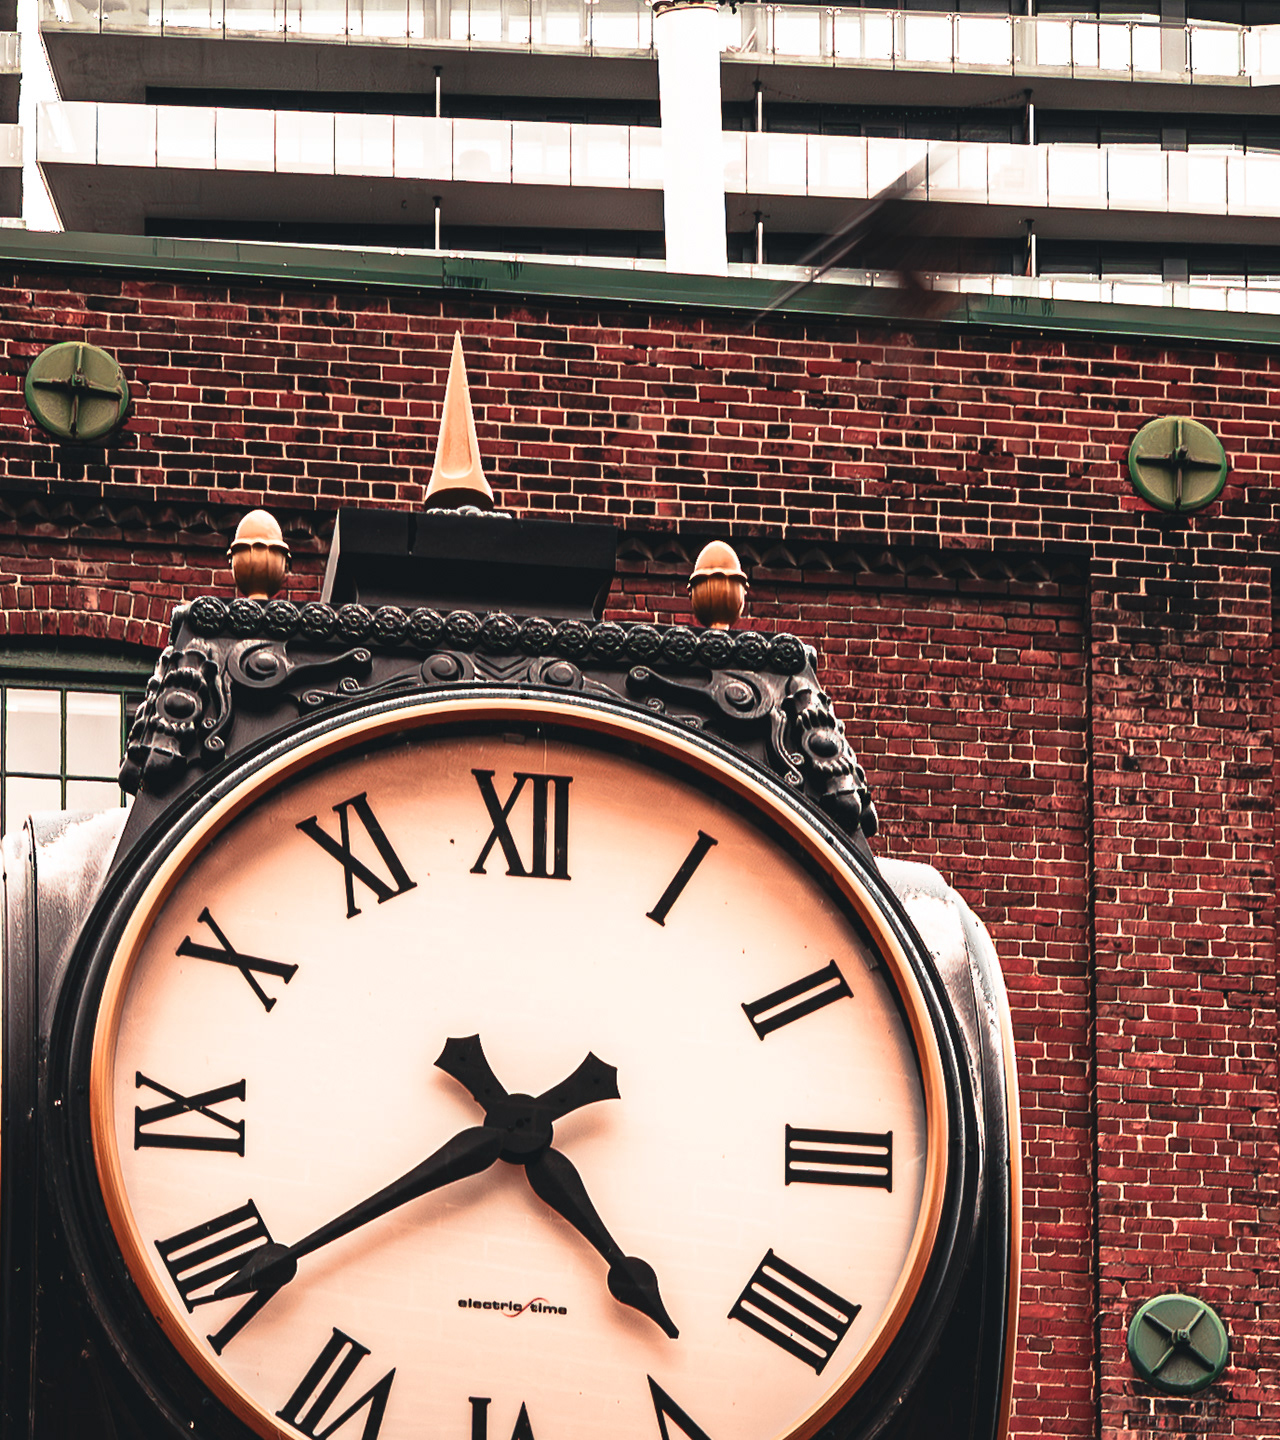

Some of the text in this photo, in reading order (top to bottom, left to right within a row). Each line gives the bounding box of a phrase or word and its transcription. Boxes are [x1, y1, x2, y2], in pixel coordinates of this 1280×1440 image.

[296, 791, 418, 918] XI
[470, 769, 574, 881] XII
[646, 830, 718, 926] I
[175, 908, 299, 1013] X
[741, 959, 855, 1041] II
[134, 1072, 246, 1157] IX
[784, 1123, 894, 1192] III
[458, 1298, 567, 1315] electric time
